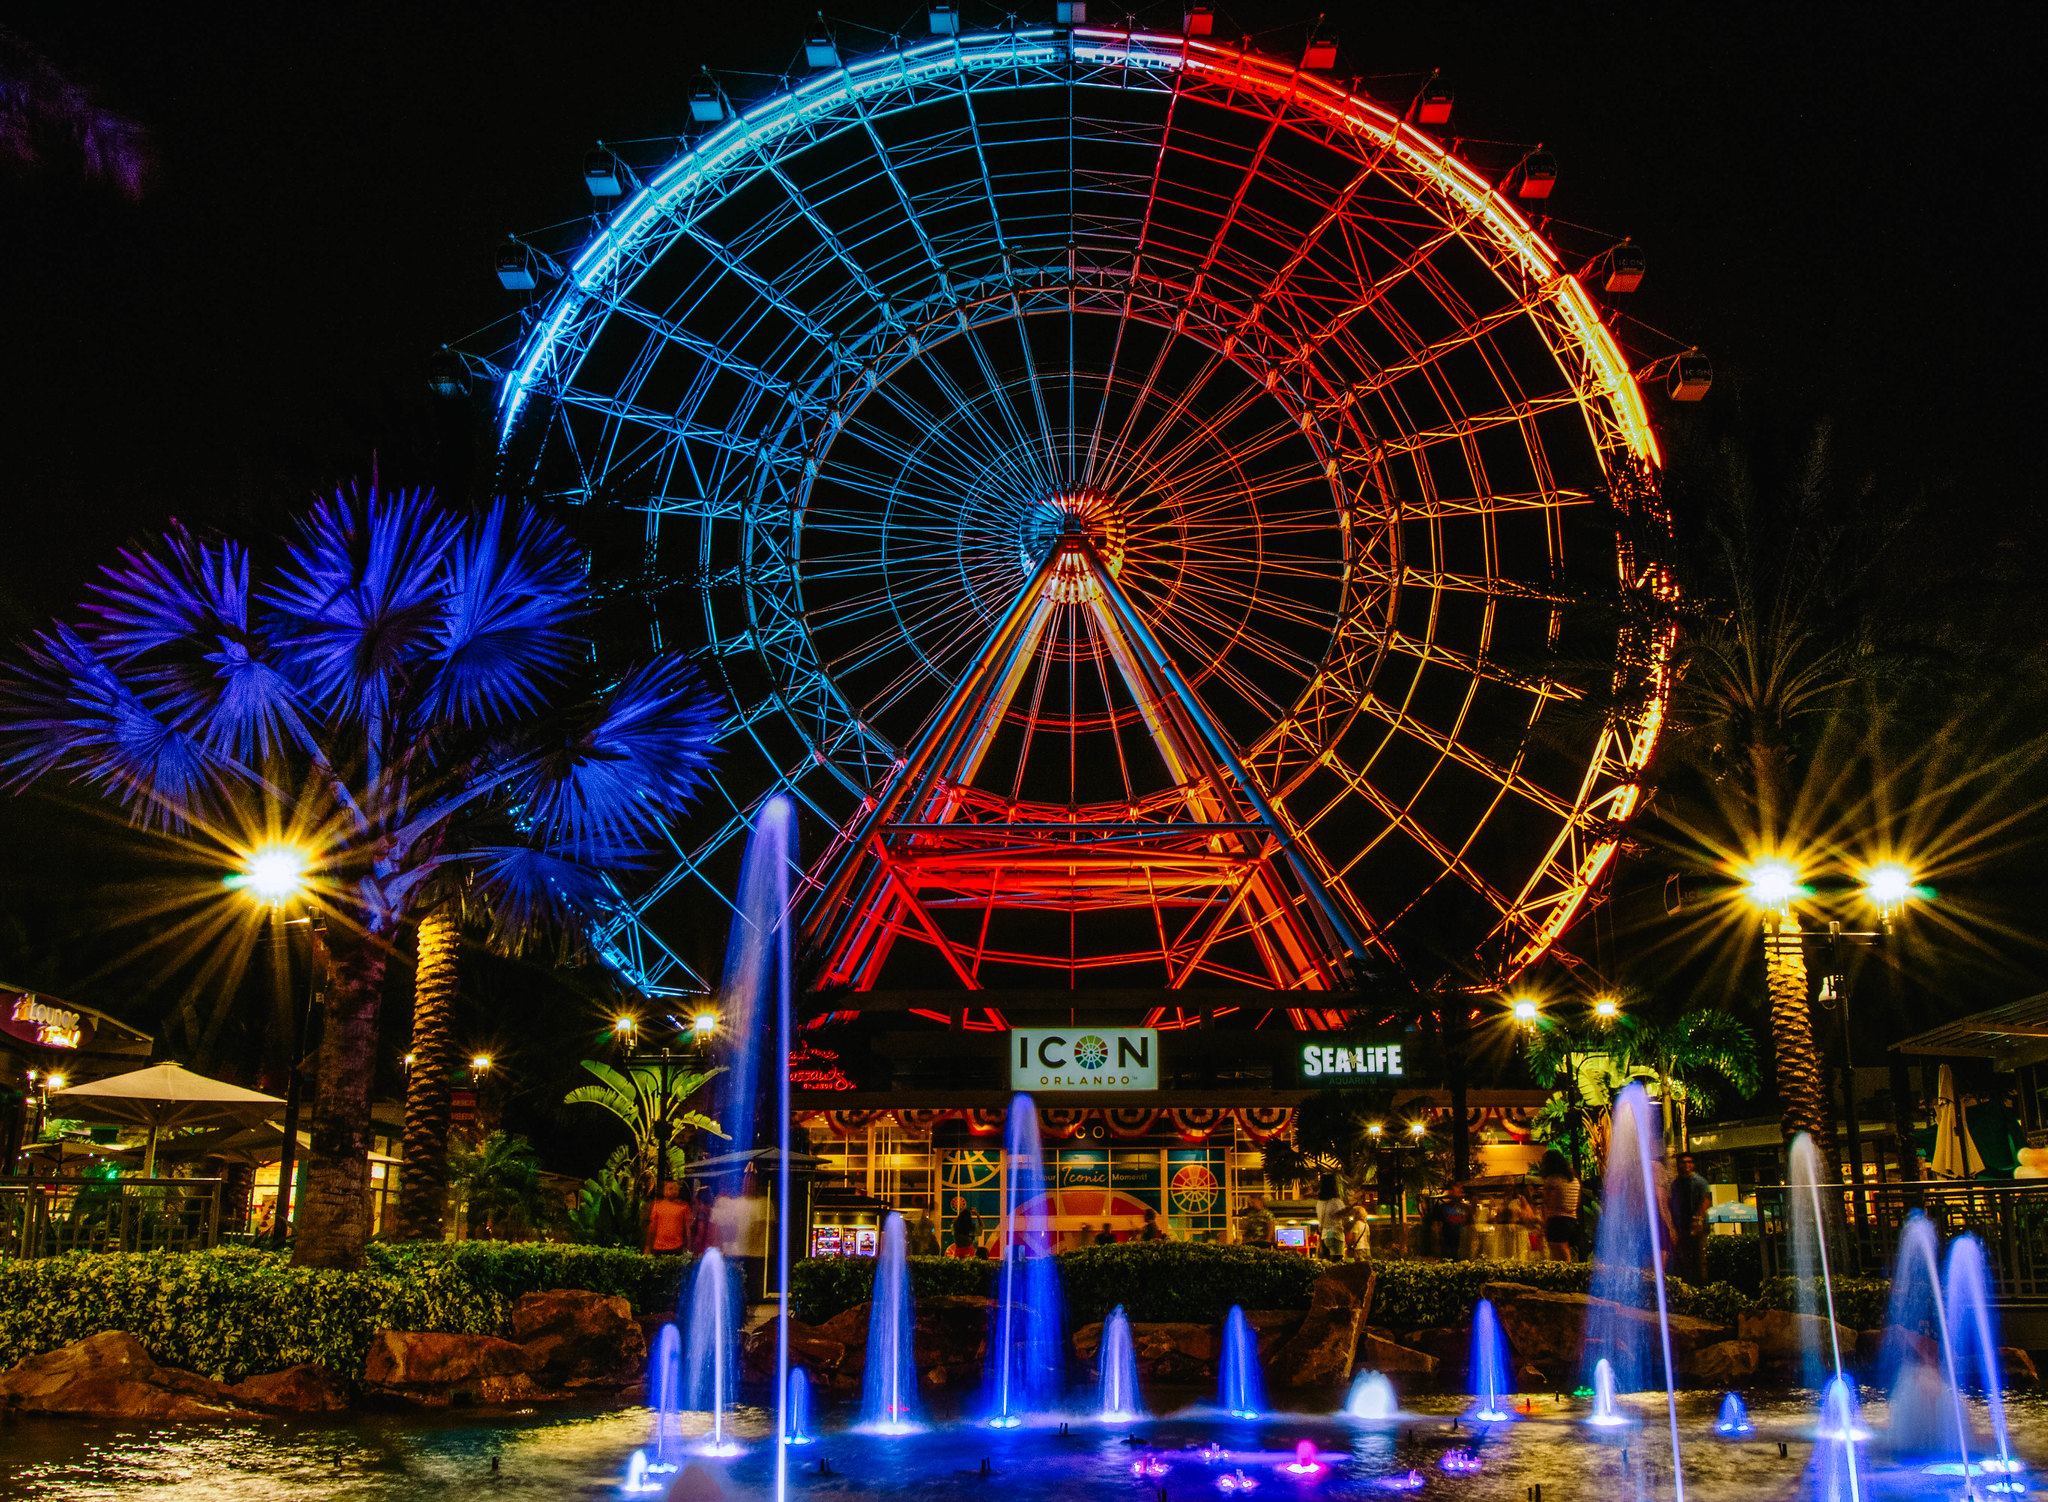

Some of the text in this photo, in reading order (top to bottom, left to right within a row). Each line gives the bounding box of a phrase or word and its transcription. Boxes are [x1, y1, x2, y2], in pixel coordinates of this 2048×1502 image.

[1019, 1036, 1149, 1069] ICON
[1304, 1045, 1351, 1076] SEA
[1061, 1165, 1108, 1187] Iconic
